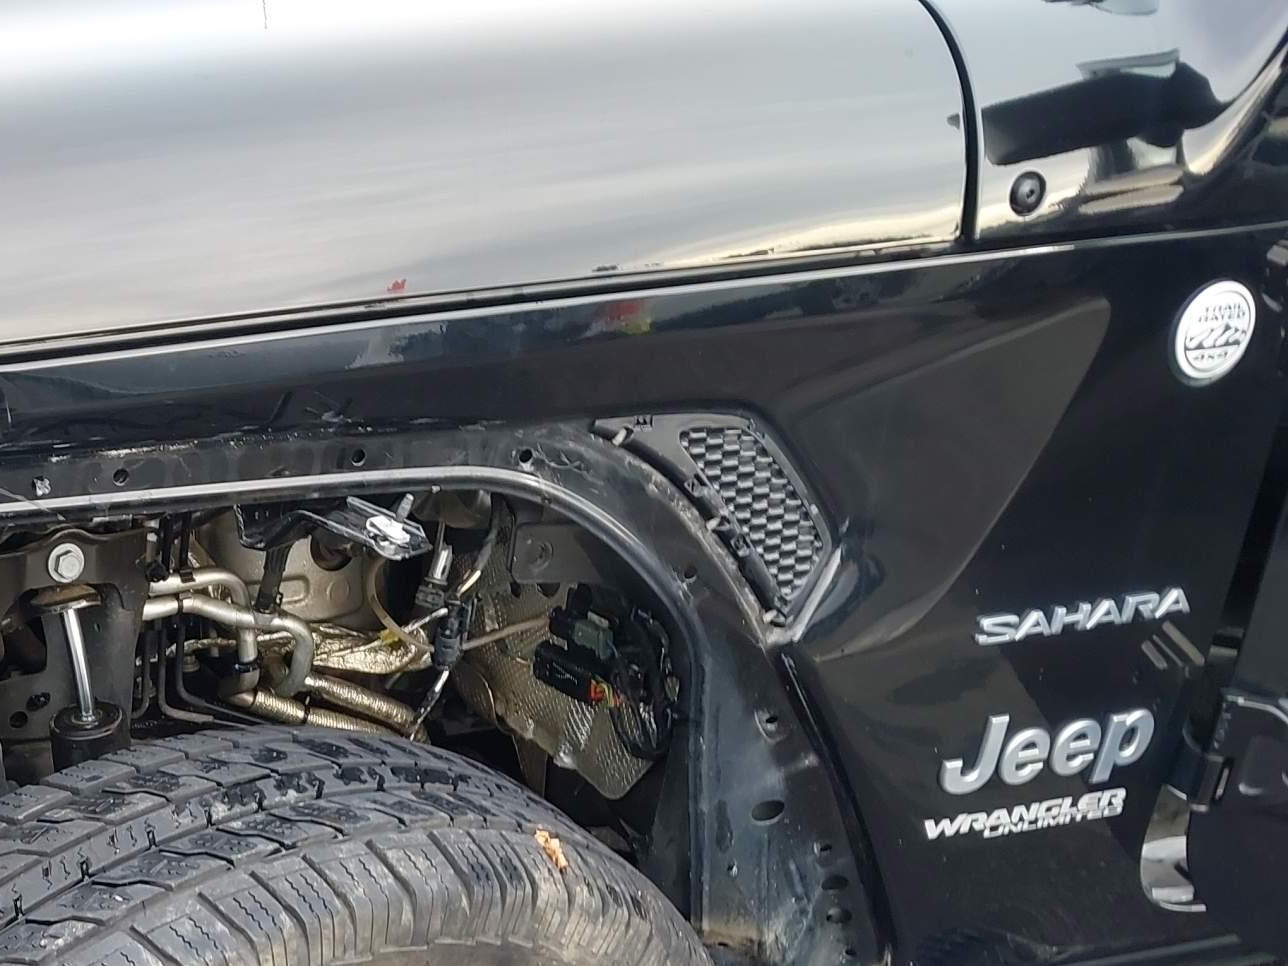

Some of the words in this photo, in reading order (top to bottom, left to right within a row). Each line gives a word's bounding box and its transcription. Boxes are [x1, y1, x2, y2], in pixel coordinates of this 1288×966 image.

[974, 586, 1191, 645] SAHARA
[938, 707, 1155, 795] Jeep
[924, 787, 1127, 840] WRANGLER
